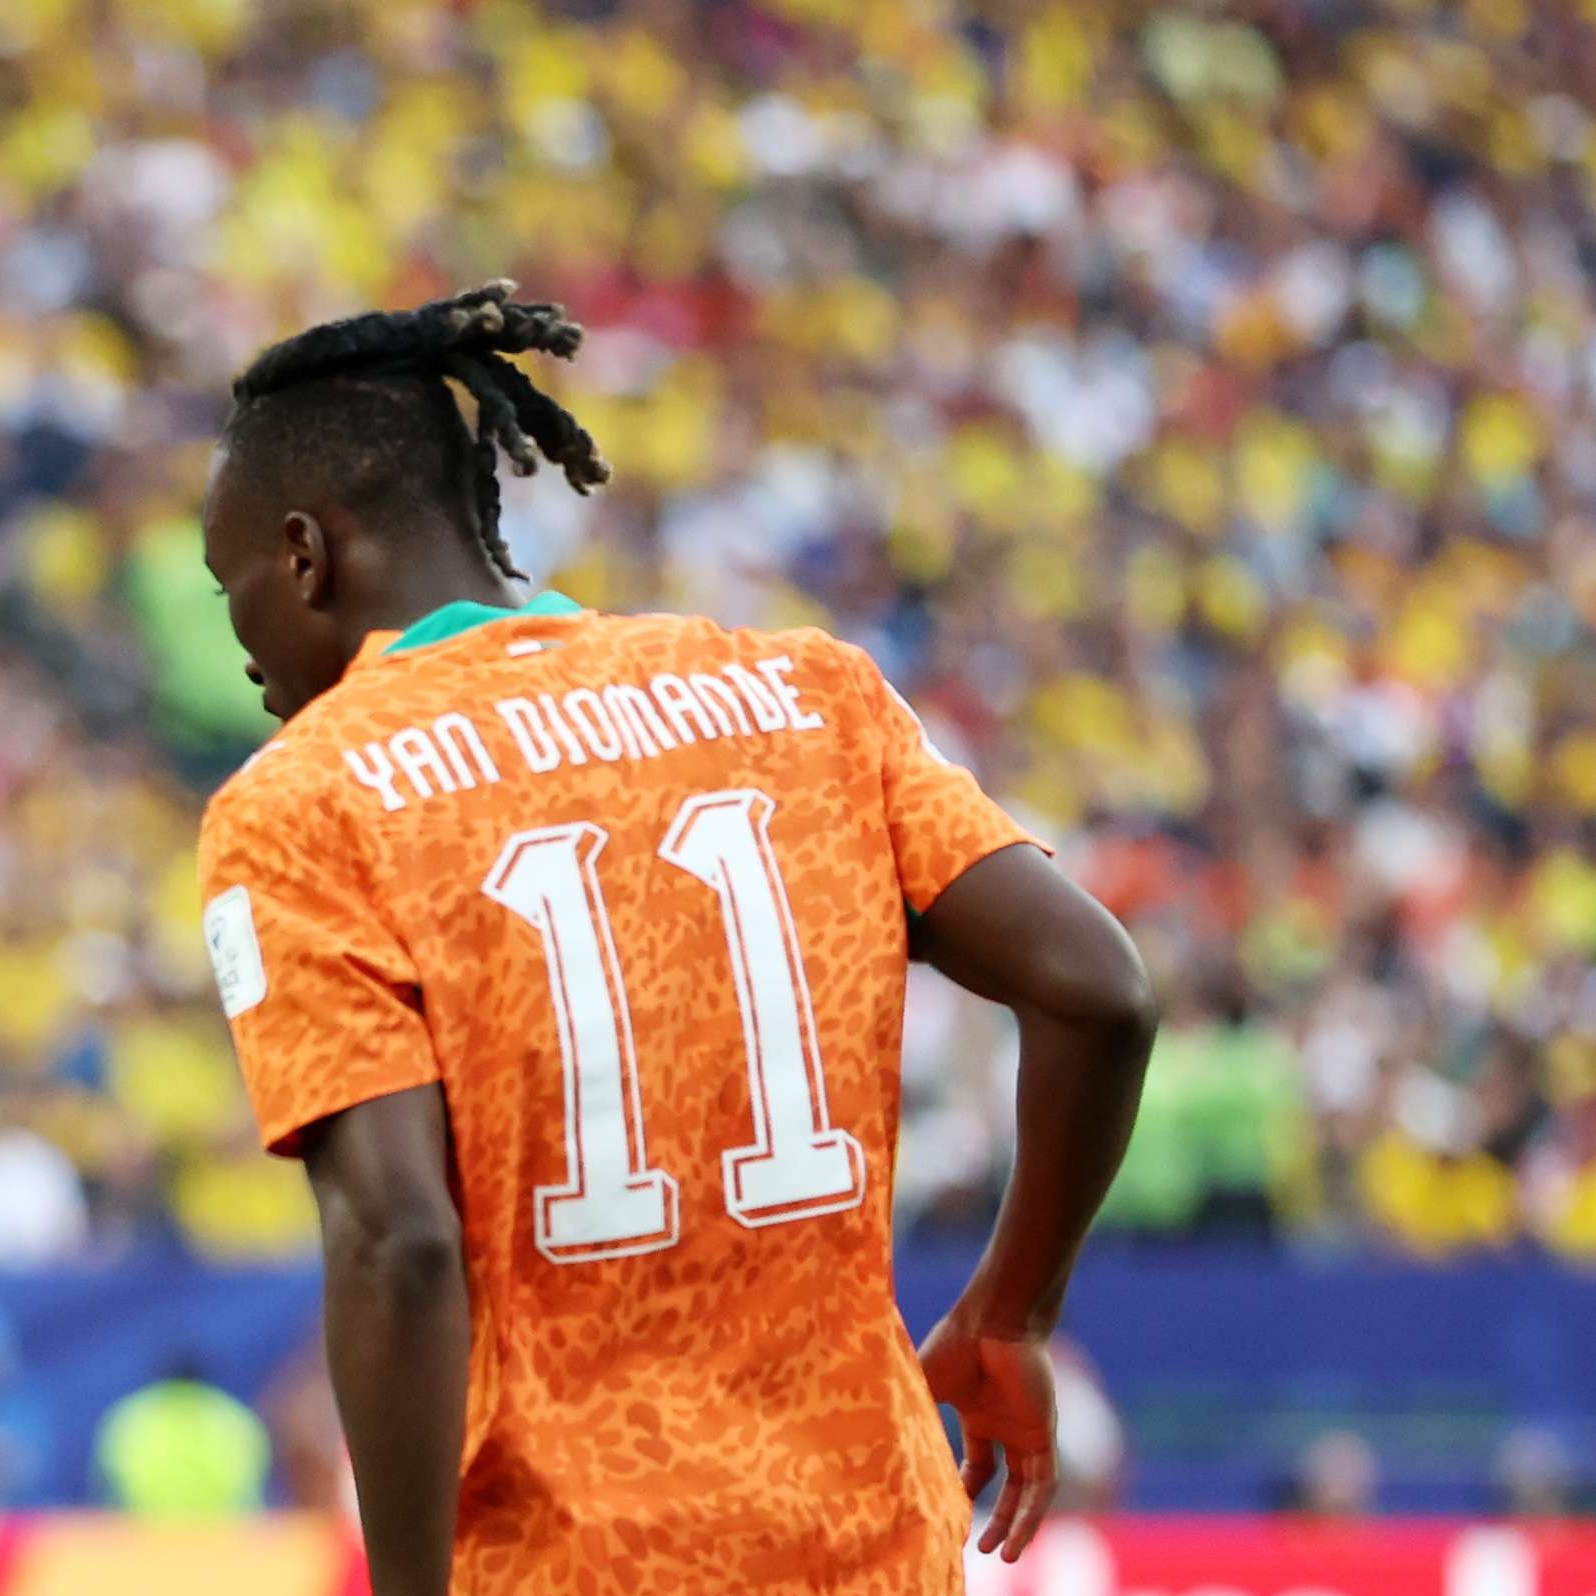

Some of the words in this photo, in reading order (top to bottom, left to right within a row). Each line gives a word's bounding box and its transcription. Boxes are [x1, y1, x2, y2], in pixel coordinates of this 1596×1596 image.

[343, 711, 501, 812] YAN
[495, 656, 824, 774] DIOMANDE
[481, 787, 865, 1264] 11
